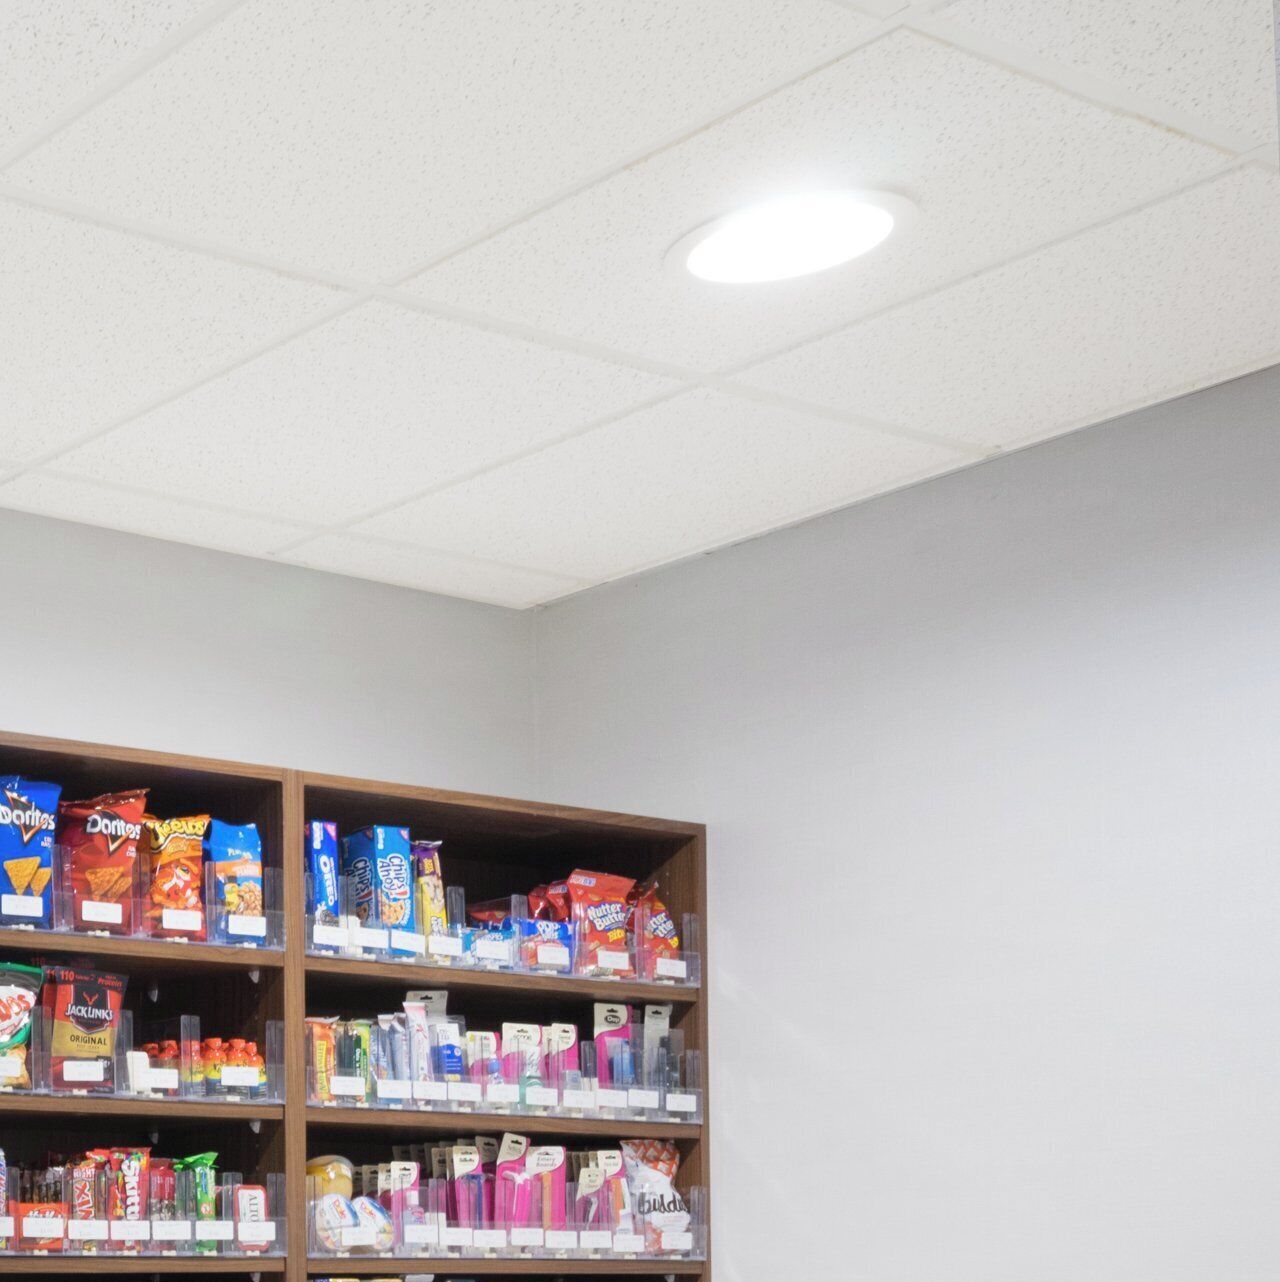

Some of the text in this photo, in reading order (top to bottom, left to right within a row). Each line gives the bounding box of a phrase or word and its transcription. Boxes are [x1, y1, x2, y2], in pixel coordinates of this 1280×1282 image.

[86, 814, 142, 840] Doritos
[389, 854, 406, 894] Chips
[587, 903, 622, 920] Nutter
[61, 970, 75, 981] 110
[65, 1003, 87, 1019] JACK
[69, 1034, 108, 1046] ORIGINAL
[121, 1158, 140, 1221] Skitt
